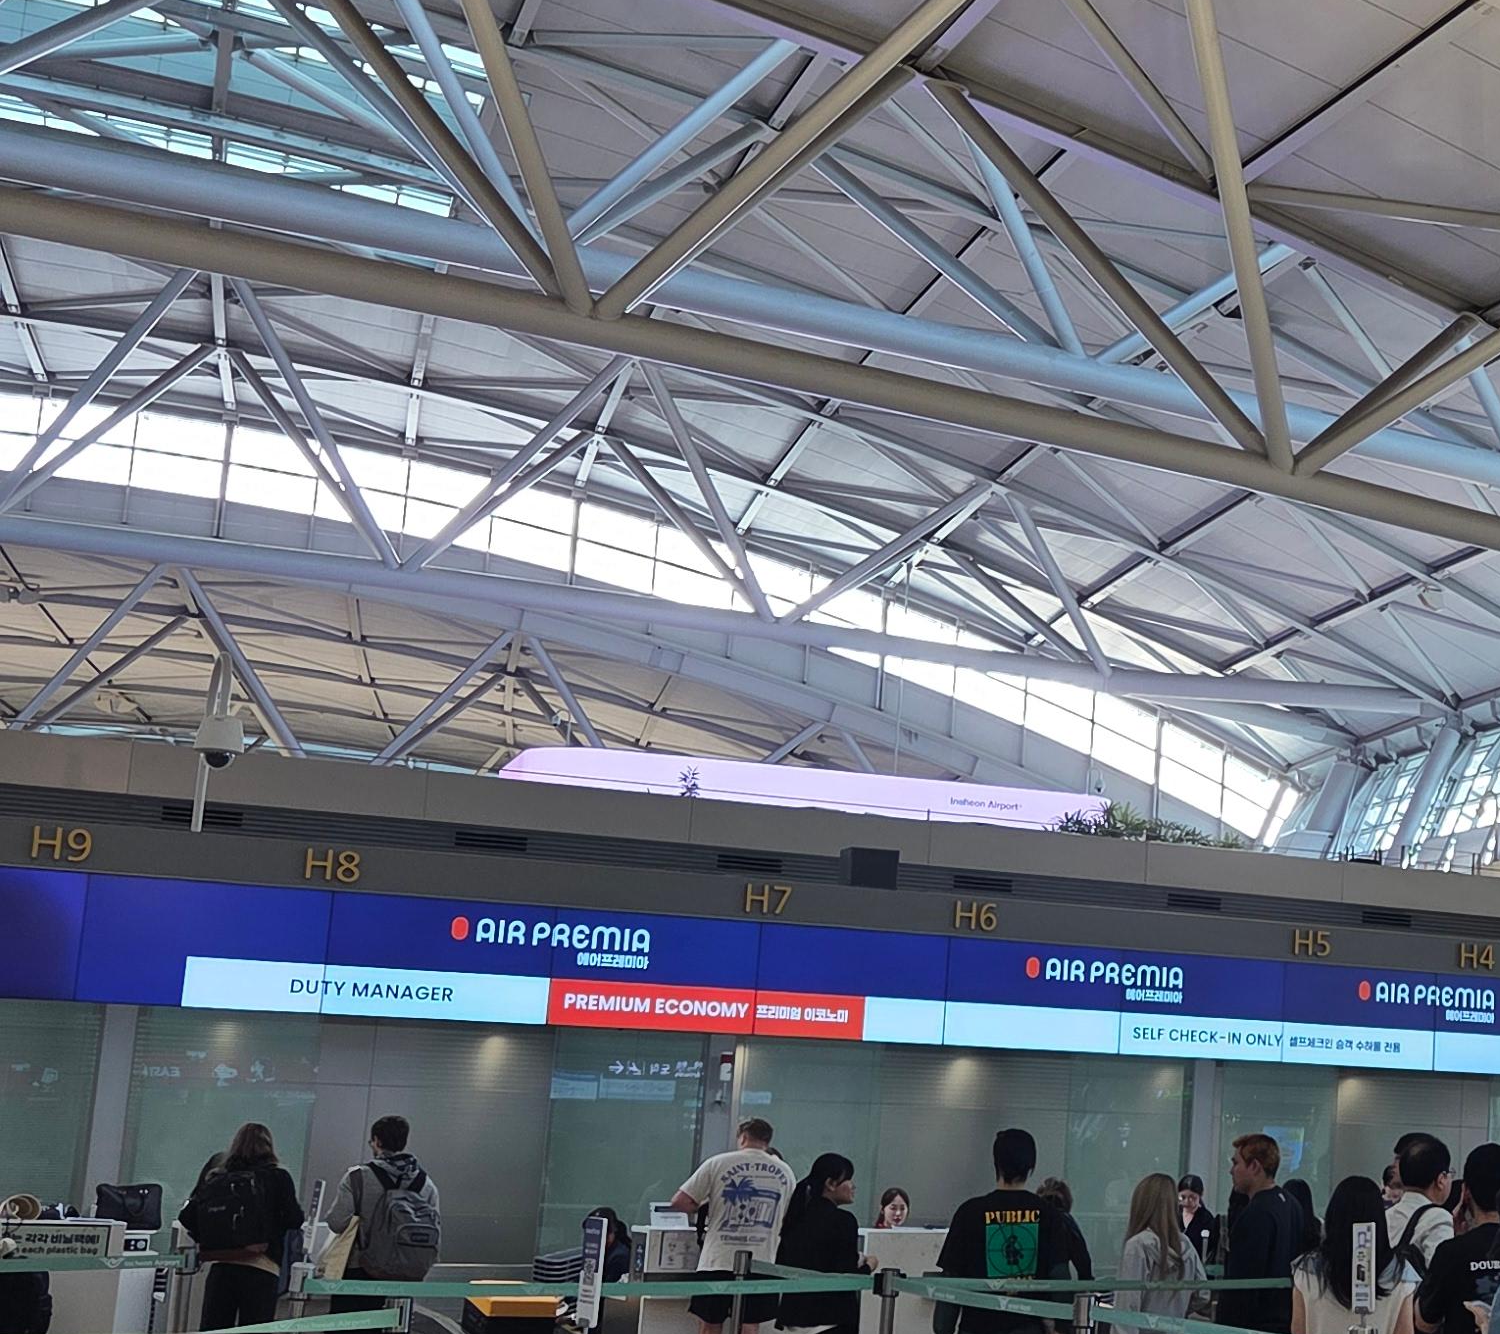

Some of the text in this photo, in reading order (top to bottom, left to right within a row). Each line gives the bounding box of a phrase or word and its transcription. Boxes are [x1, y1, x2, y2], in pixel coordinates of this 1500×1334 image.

[988, 800, 1018, 811] Airport
[30, 825, 93, 862] H9
[304, 847, 361, 883] H8
[744, 883, 793, 915] H7
[954, 900, 999, 931] H6
[475, 917, 651, 953] AIR PREMIA
[1293, 928, 1332, 957] H5
[577, 952, 649, 970] 에어프레미아
[1460, 942, 1495, 970] H4
[1045, 957, 1184, 989] AIR PREMIA
[289, 977, 454, 1003] DUTY MANAGER
[1375, 981, 1495, 1011] AIR PREMIA
[563, 993, 749, 1019] PREMIUM ECONOMY
[756, 1004, 849, 1023] 프리미엄 이코노미
[1132, 1026, 1283, 1047] SELF CHECK-IN ONLY
[984, 1210, 1040, 1224] PUBLIC
[21, 1246, 44, 1254] each
[46, 1246, 79, 1255] plastic
[80, 1247, 98, 1256] bag
